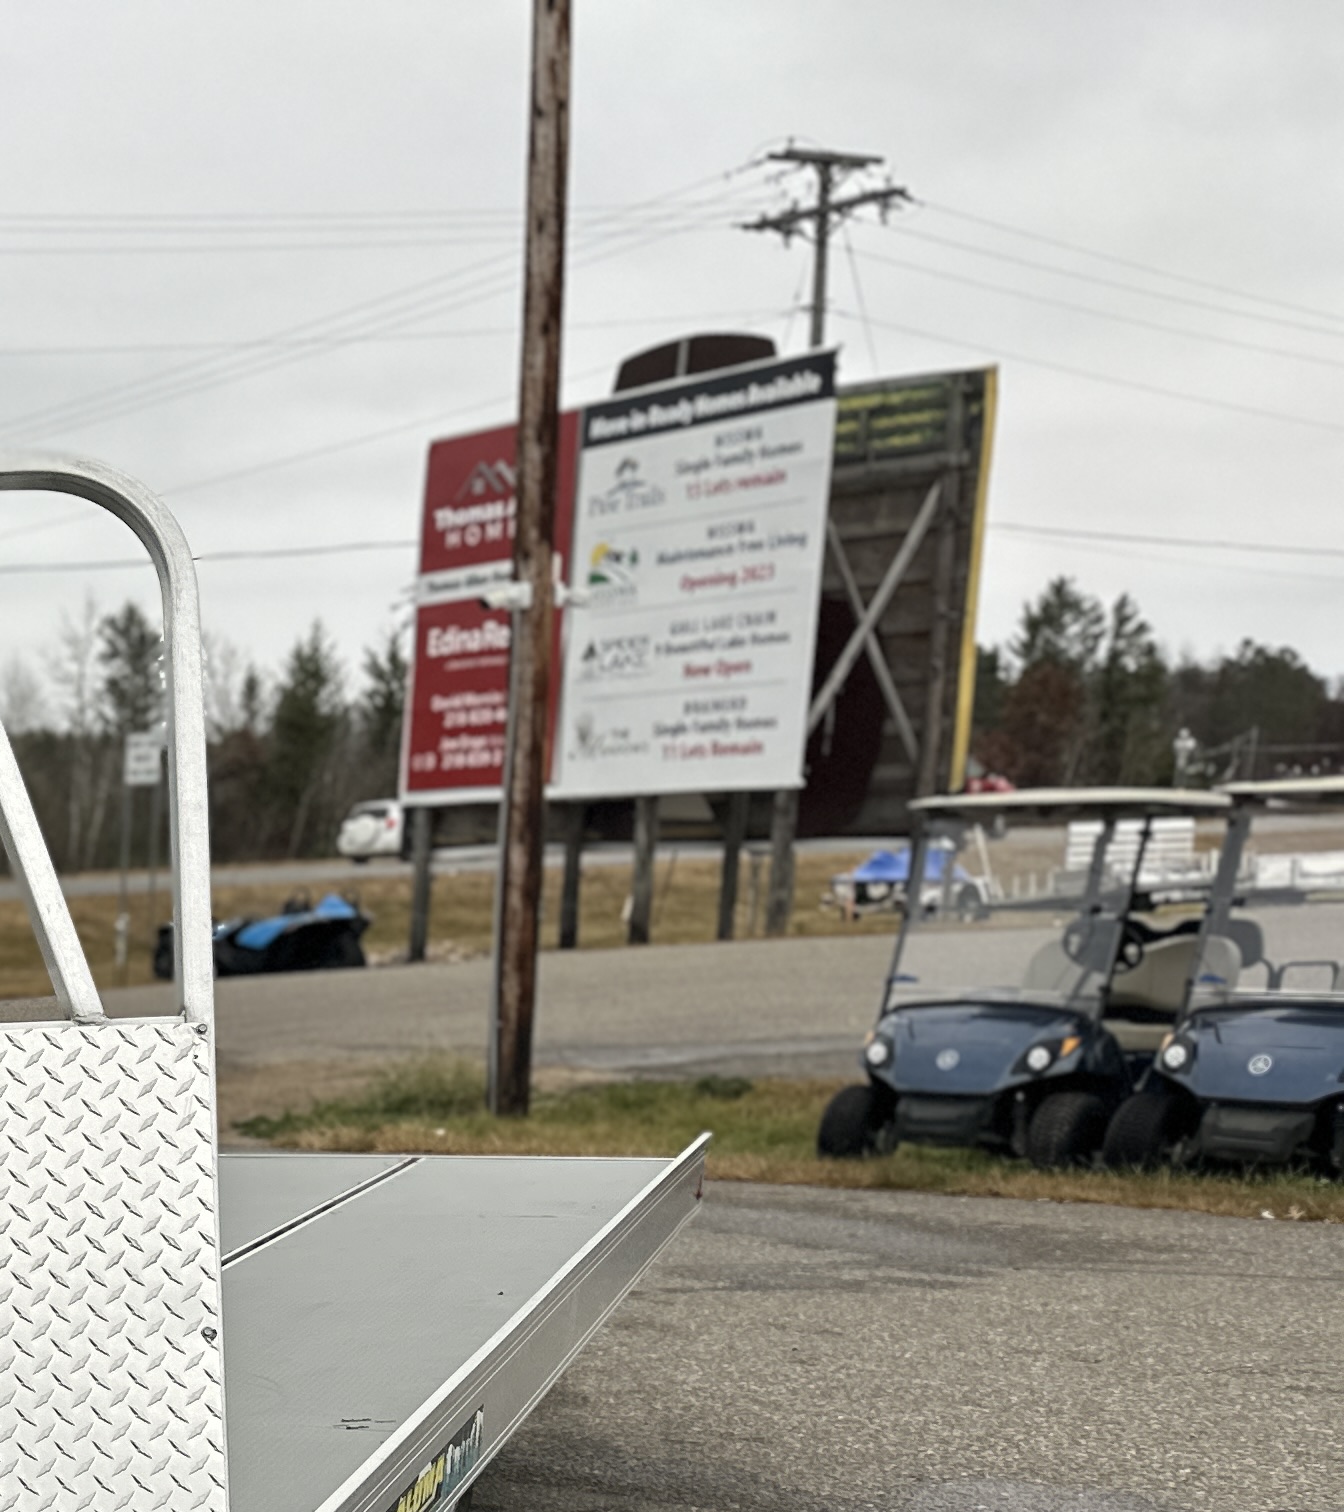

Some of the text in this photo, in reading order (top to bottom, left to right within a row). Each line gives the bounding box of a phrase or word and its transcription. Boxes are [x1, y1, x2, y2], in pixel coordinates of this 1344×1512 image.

[696, 391, 747, 417] Homes
[749, 371, 823, 407] Available
[433, 500, 505, 531] Thomas
[679, 570, 737, 595] Opening
